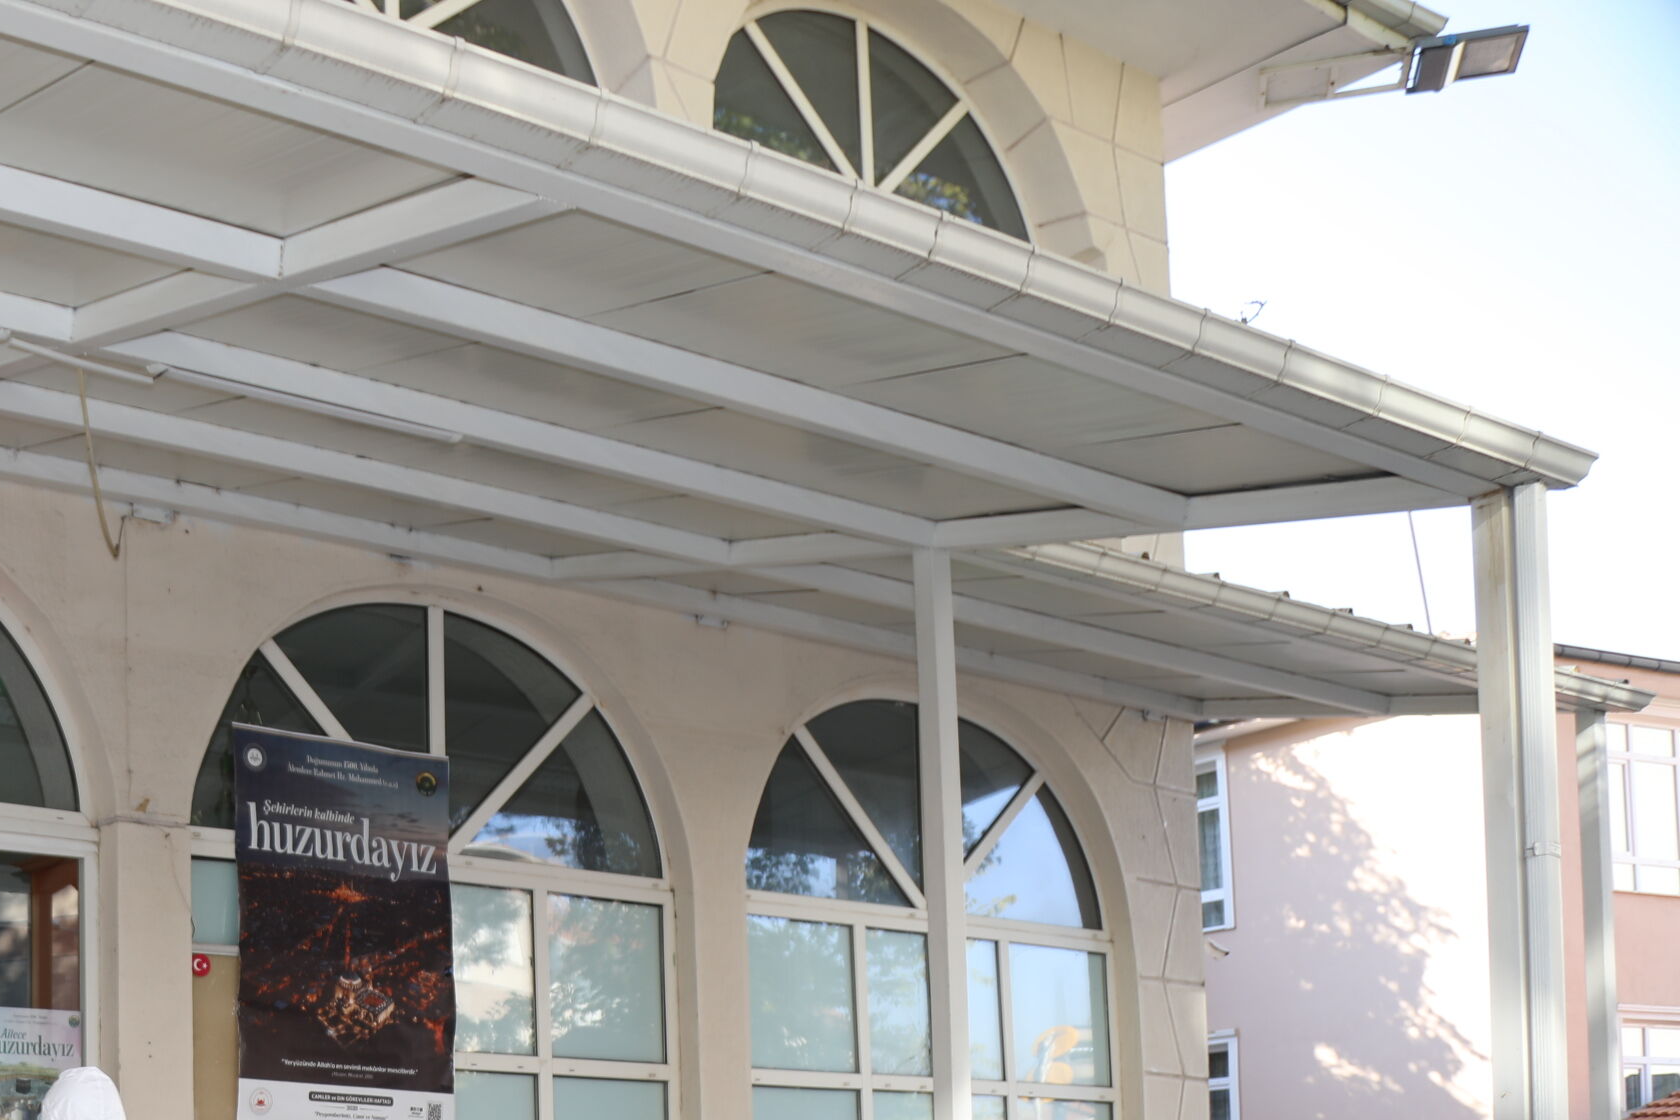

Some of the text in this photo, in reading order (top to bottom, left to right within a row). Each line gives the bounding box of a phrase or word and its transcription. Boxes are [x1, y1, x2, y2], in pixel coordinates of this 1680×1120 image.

[263, 799, 356, 825] Şehirlerin kalbinde
[247, 801, 437, 883] huzurdayız
